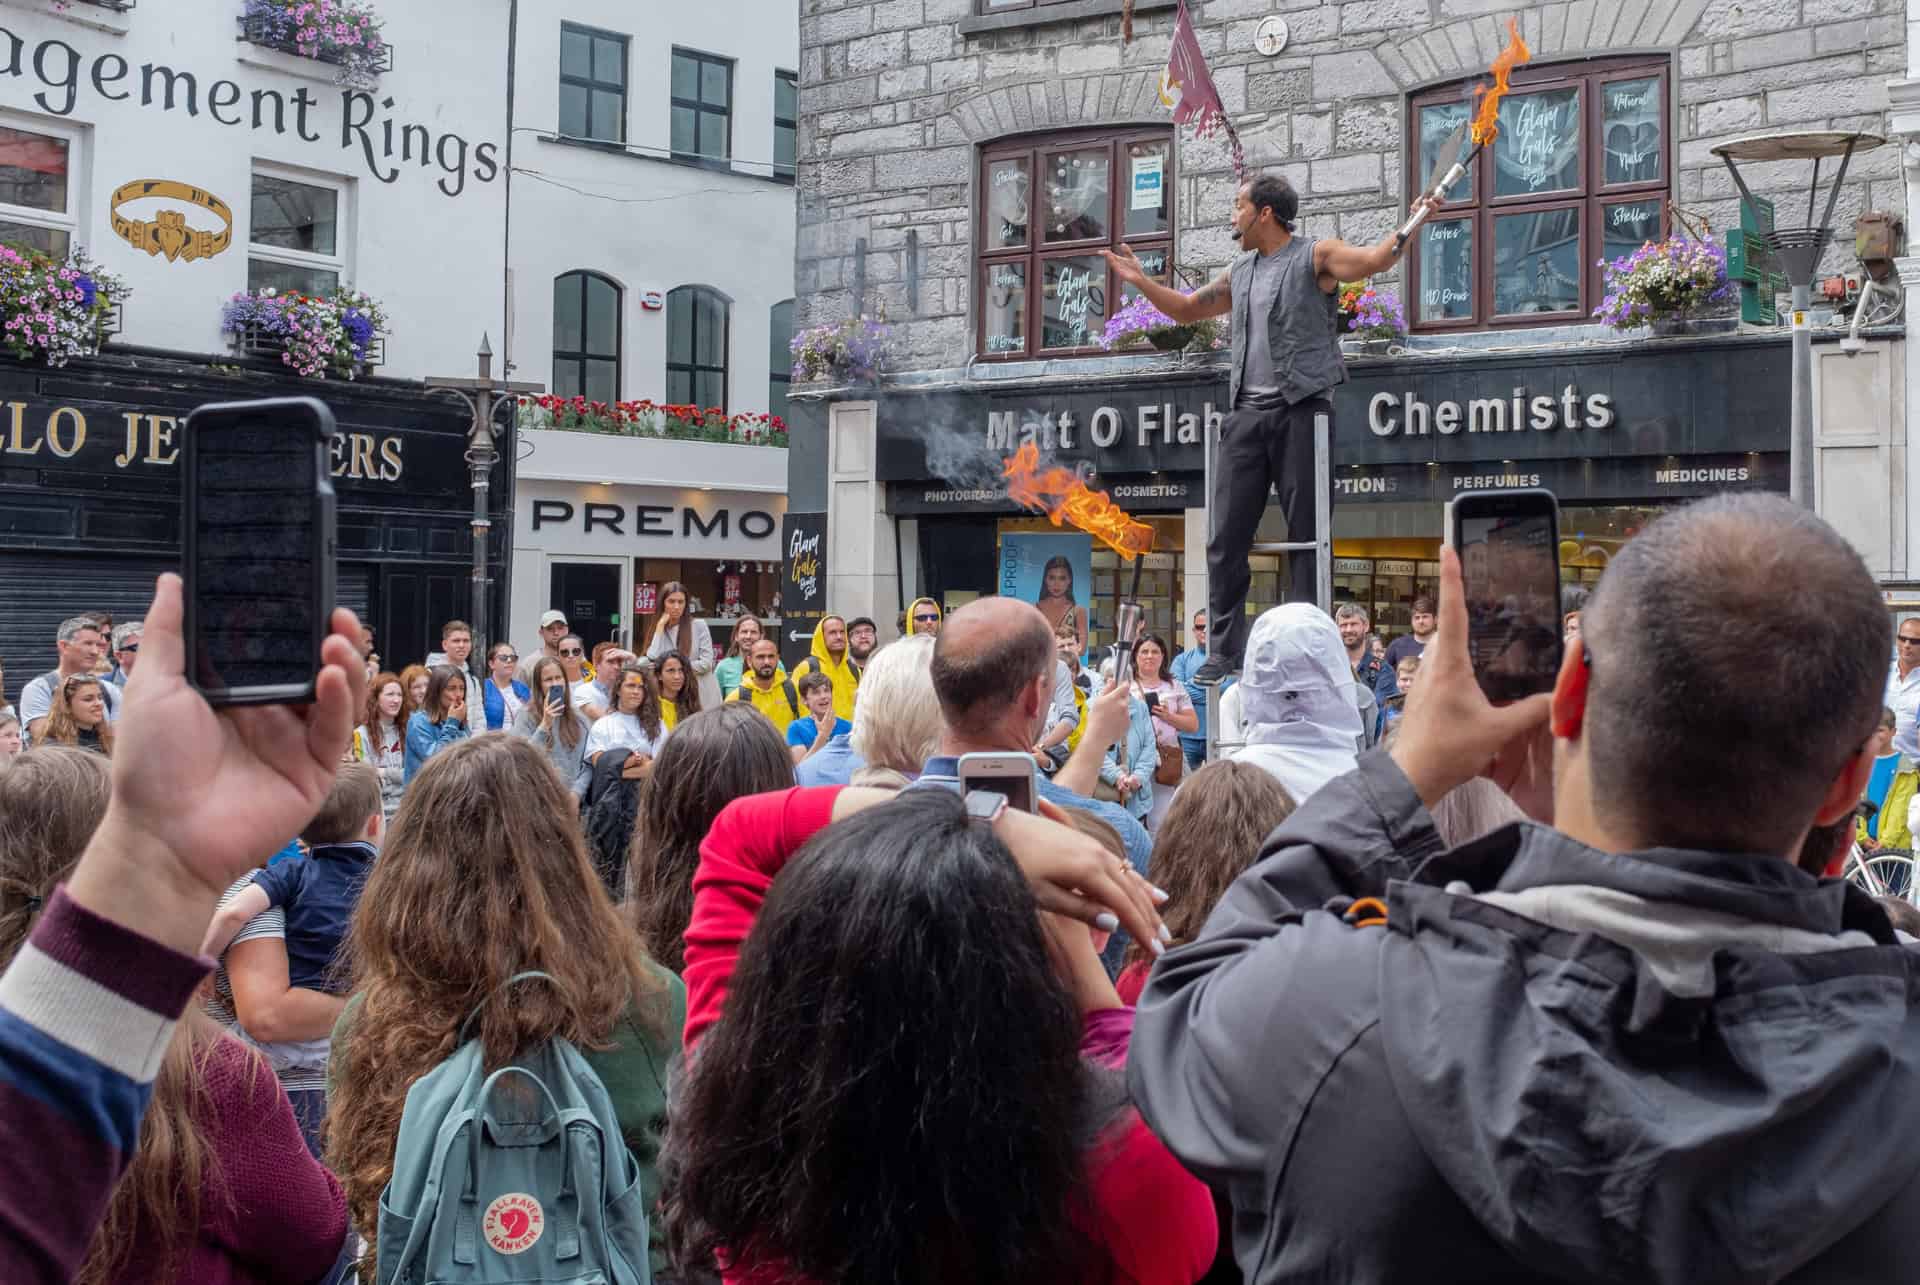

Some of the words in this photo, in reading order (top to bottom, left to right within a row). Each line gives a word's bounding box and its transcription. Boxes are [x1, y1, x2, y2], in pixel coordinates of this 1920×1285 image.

[1516, 102, 1559, 136] Glam
[342, 90, 498, 197] Rings
[1520, 128, 1561, 165] Gals
[1057, 267, 1089, 297] Glam
[1060, 291, 1091, 321] Gals
[0, 402, 87, 458] LO
[986, 409, 1075, 450] Matt
[1091, 406, 1122, 448] O
[1138, 402, 1226, 447] Flah
[1368, 383, 1615, 438] Chemists
[1115, 484, 1188, 498] COSMETICS
[1453, 472, 1540, 490] PERFUMES
[1656, 467, 1749, 484] MEDICINES
[532, 500, 776, 539] PREMO
[789, 528, 820, 558] Glam
[792, 552, 820, 584] Gals
[635, 599, 656, 609] OFF
